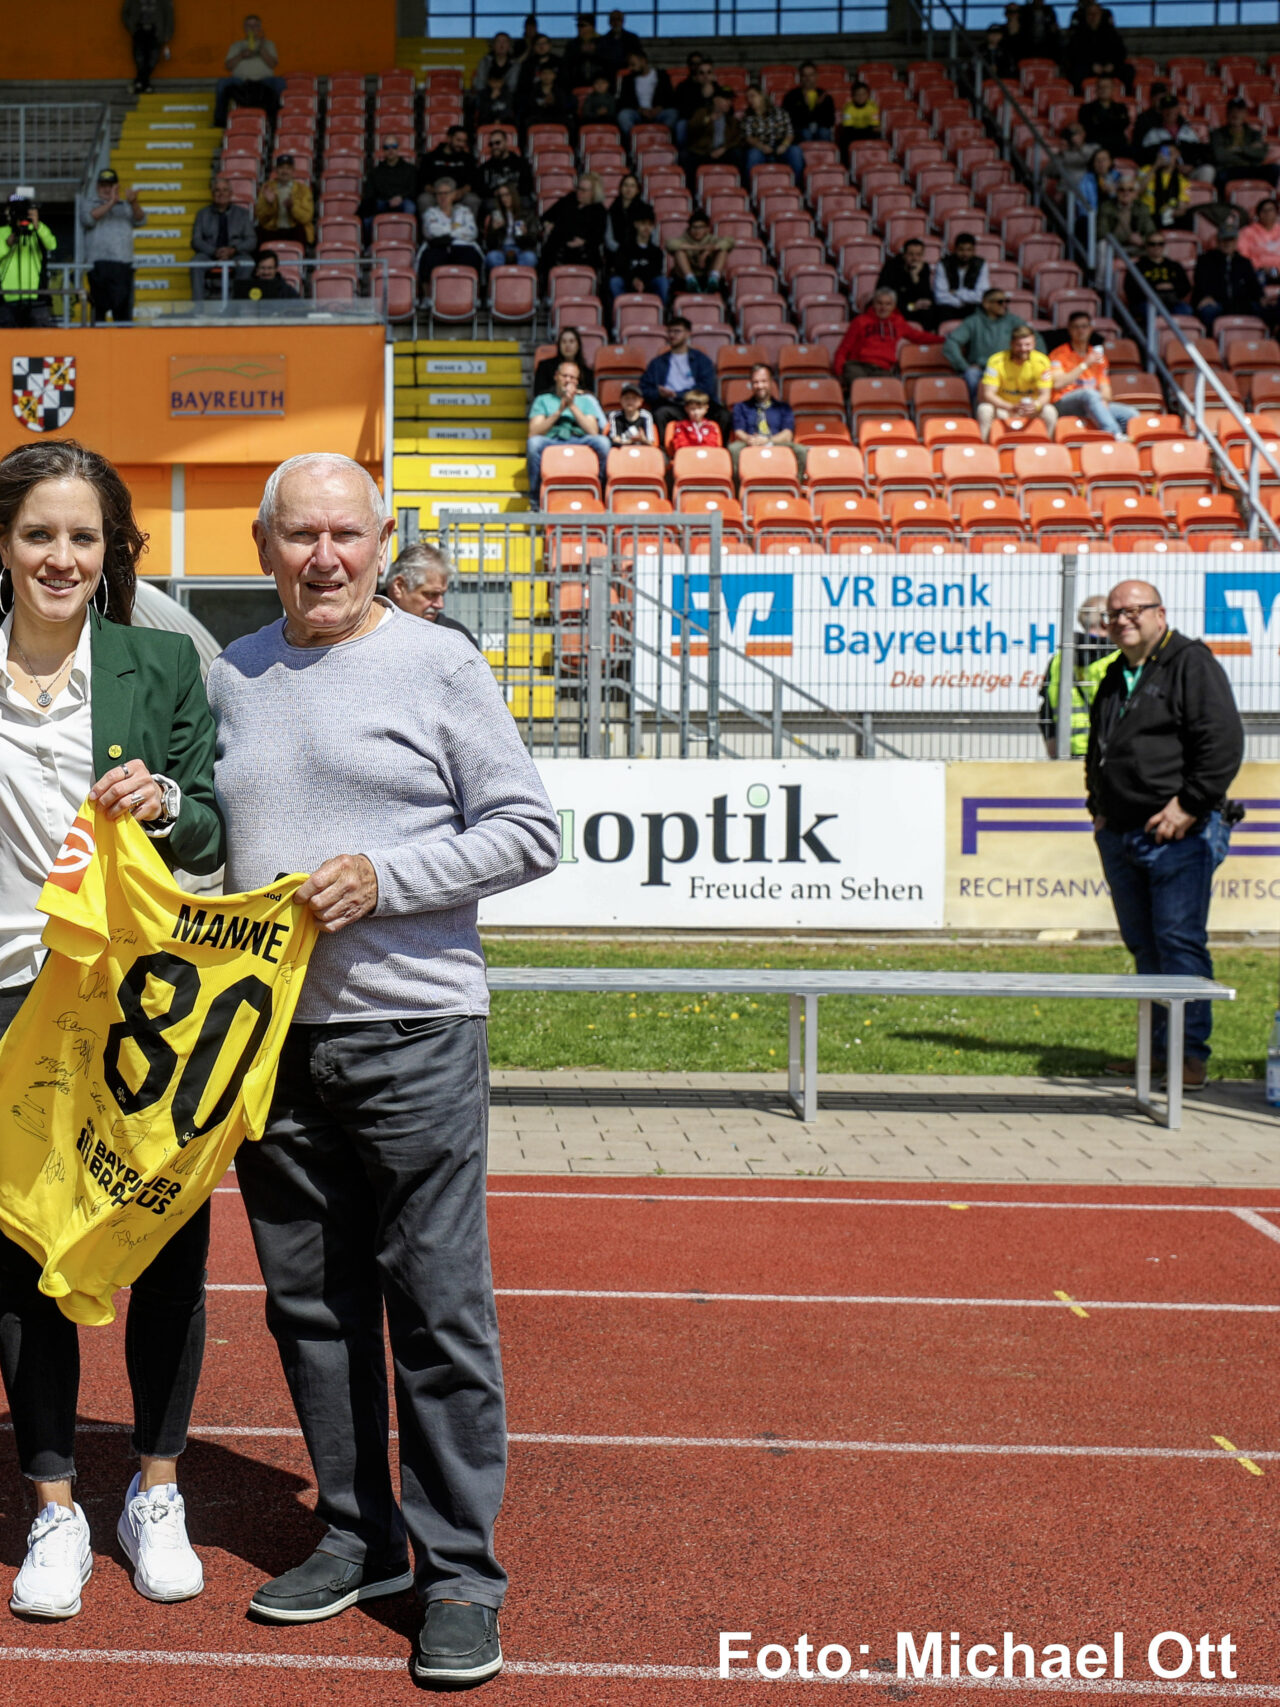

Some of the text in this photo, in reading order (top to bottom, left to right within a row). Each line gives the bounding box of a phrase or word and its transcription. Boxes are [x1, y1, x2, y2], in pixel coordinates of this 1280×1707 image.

[171, 391, 285, 414] BAYREUTH
[821, 573, 991, 607] VR Bank
[824, 621, 1056, 664] Bayreuth-H
[889, 670, 926, 688] Die
[931, 670, 1013, 693] richtige
[689, 876, 924, 900] Freude am Sehen
[171, 904, 290, 964] MANNE
[104, 951, 273, 1148] 80
